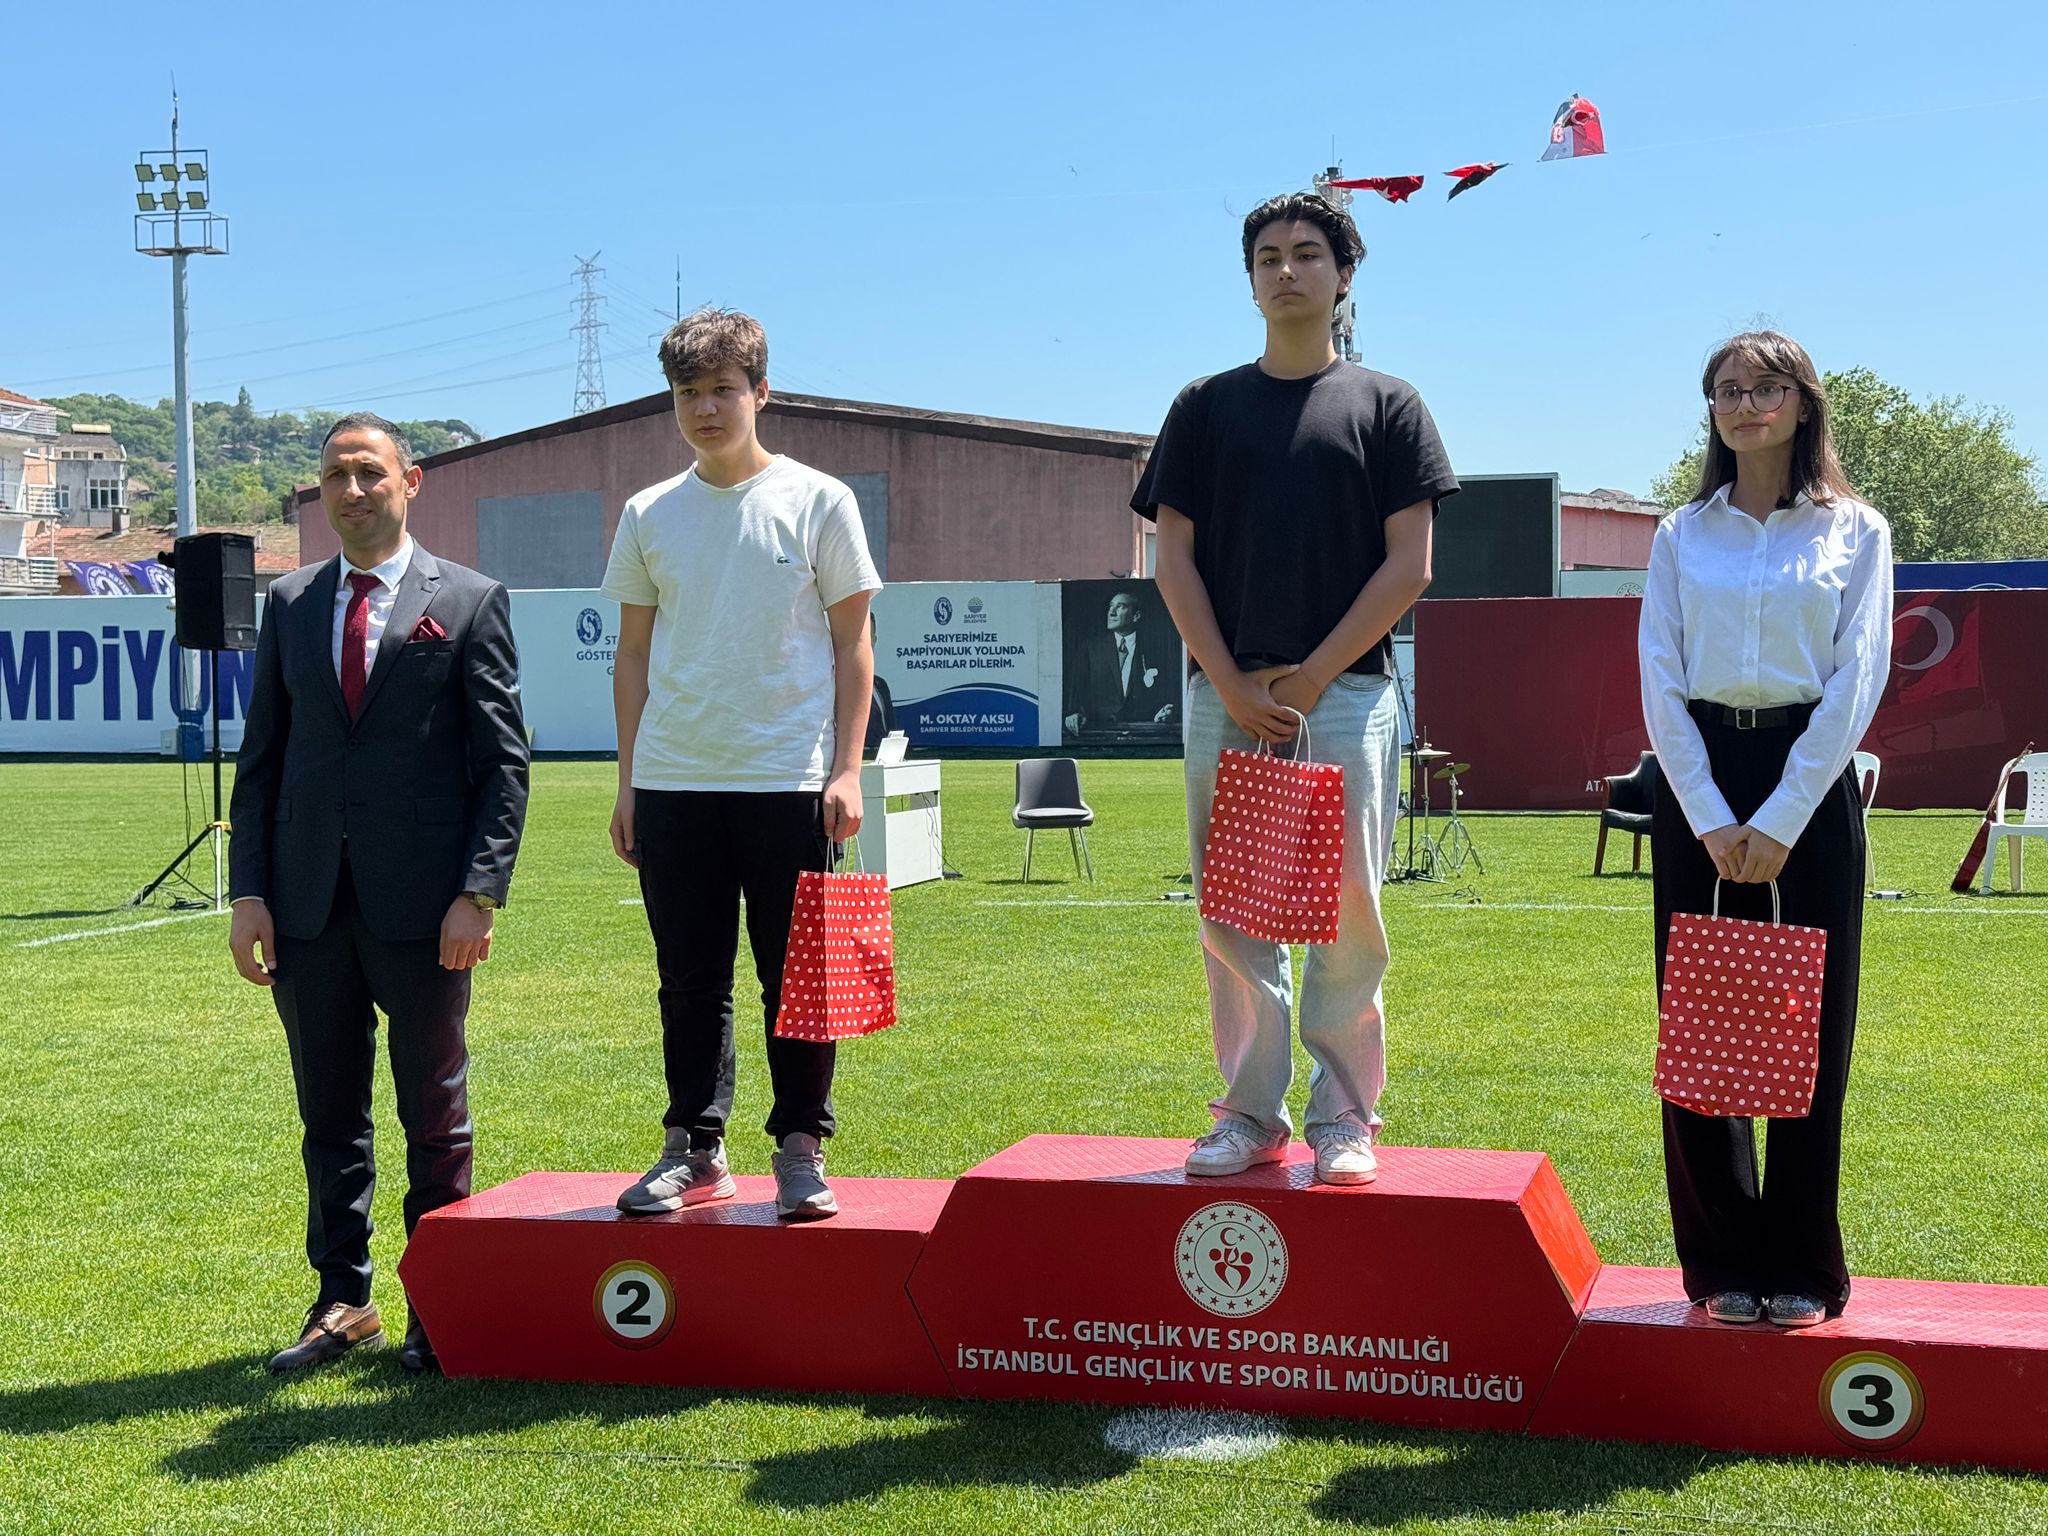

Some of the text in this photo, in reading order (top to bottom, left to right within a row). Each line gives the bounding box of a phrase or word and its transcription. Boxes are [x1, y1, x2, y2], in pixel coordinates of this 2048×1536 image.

[923, 632, 998, 644] SARIYERİMİZE
[896, 645, 1026, 658] ŞAMPİYONLUK YOLUNDA
[906, 657, 1015, 671] BAŞARILAR DİLERİM.
[919, 713, 1015, 725] M. OKTAY AKSU
[920, 726, 949, 734] SARIYER
[950, 725, 983, 734] BELEDİYE
[616, 1280, 651, 1325] 2
[1023, 1317, 1449, 1364] T.C. GENÇLİK VE SPOR BAKANLIĞI
[957, 1343, 1524, 1404] İSTANBUL GENÇLİK VE SPOR İL MÜDÜRLÜĞÜ
[1847, 1374, 1896, 1428] 3
